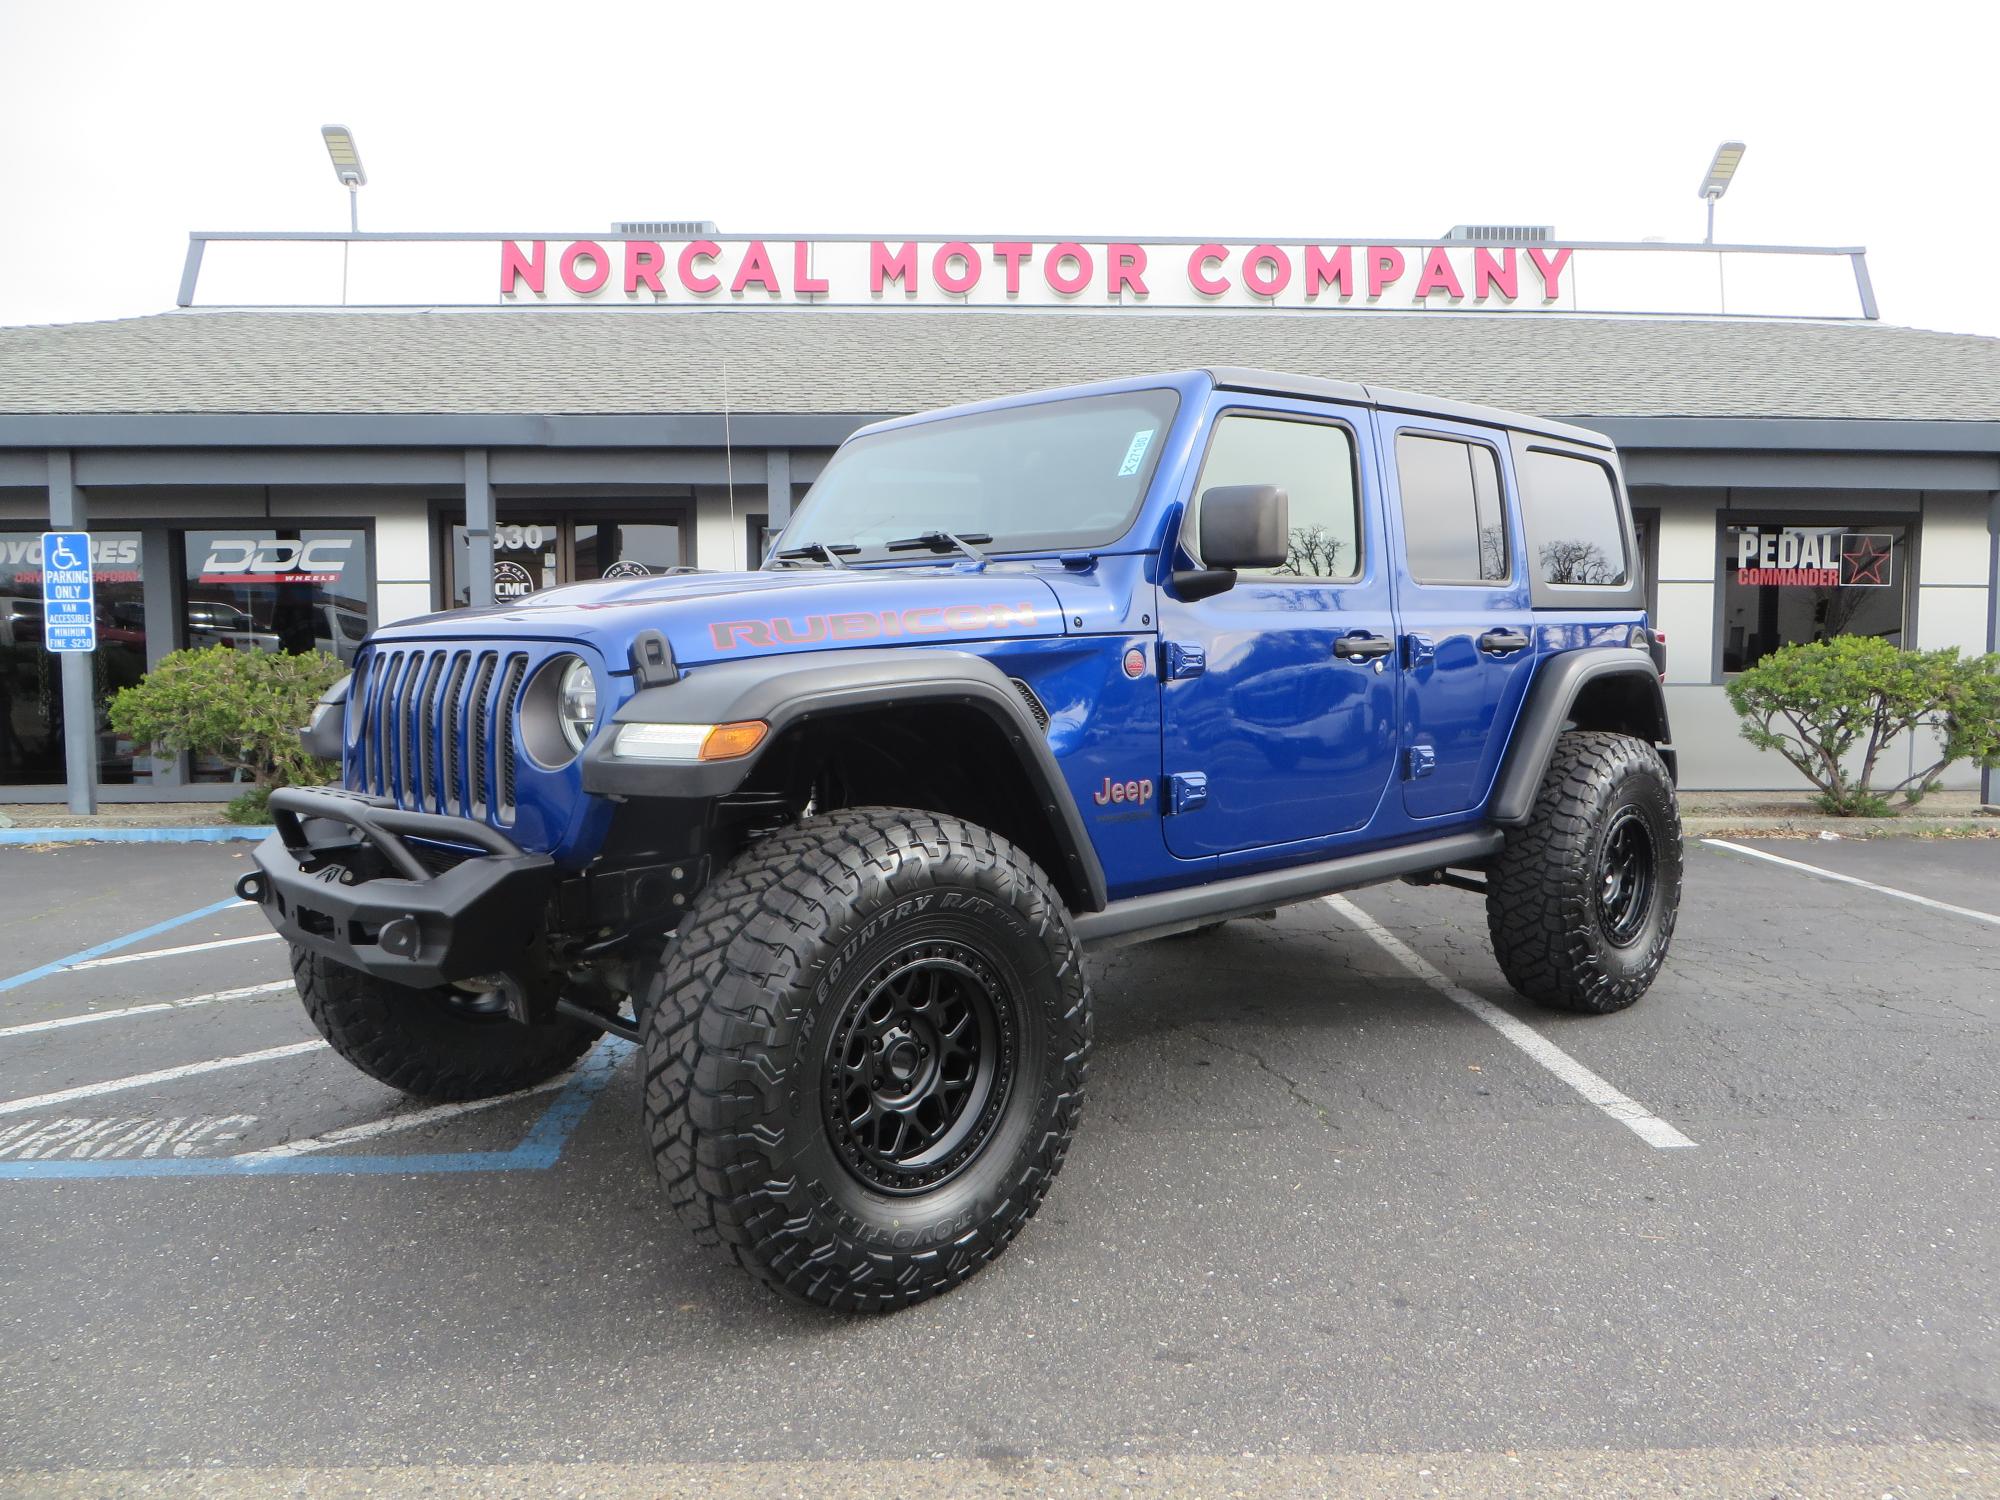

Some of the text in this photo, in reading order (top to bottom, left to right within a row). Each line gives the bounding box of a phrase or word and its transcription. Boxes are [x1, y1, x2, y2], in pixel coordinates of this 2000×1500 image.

[501, 240, 1573, 300] NORCAL MOTOR COMPANY
[202, 539, 353, 572] DDC
[1737, 533, 1839, 569] PEDAL
[46, 570, 89, 584] PARKING
[1737, 568, 1840, 586] COMMANDER
[54, 585, 81, 599] ONLY
[49, 614, 90, 624] ACCESSIBLE
[62, 603, 77, 613] VAN
[54, 628, 86, 637] MINIMUM
[708, 602, 1040, 650] RUBICON
[50, 638, 91, 648] FINE $250
[1094, 777, 1153, 806] Jeep
[815, 893, 935, 1006] COUNTRY
[891, 1208, 974, 1249] TOYO
